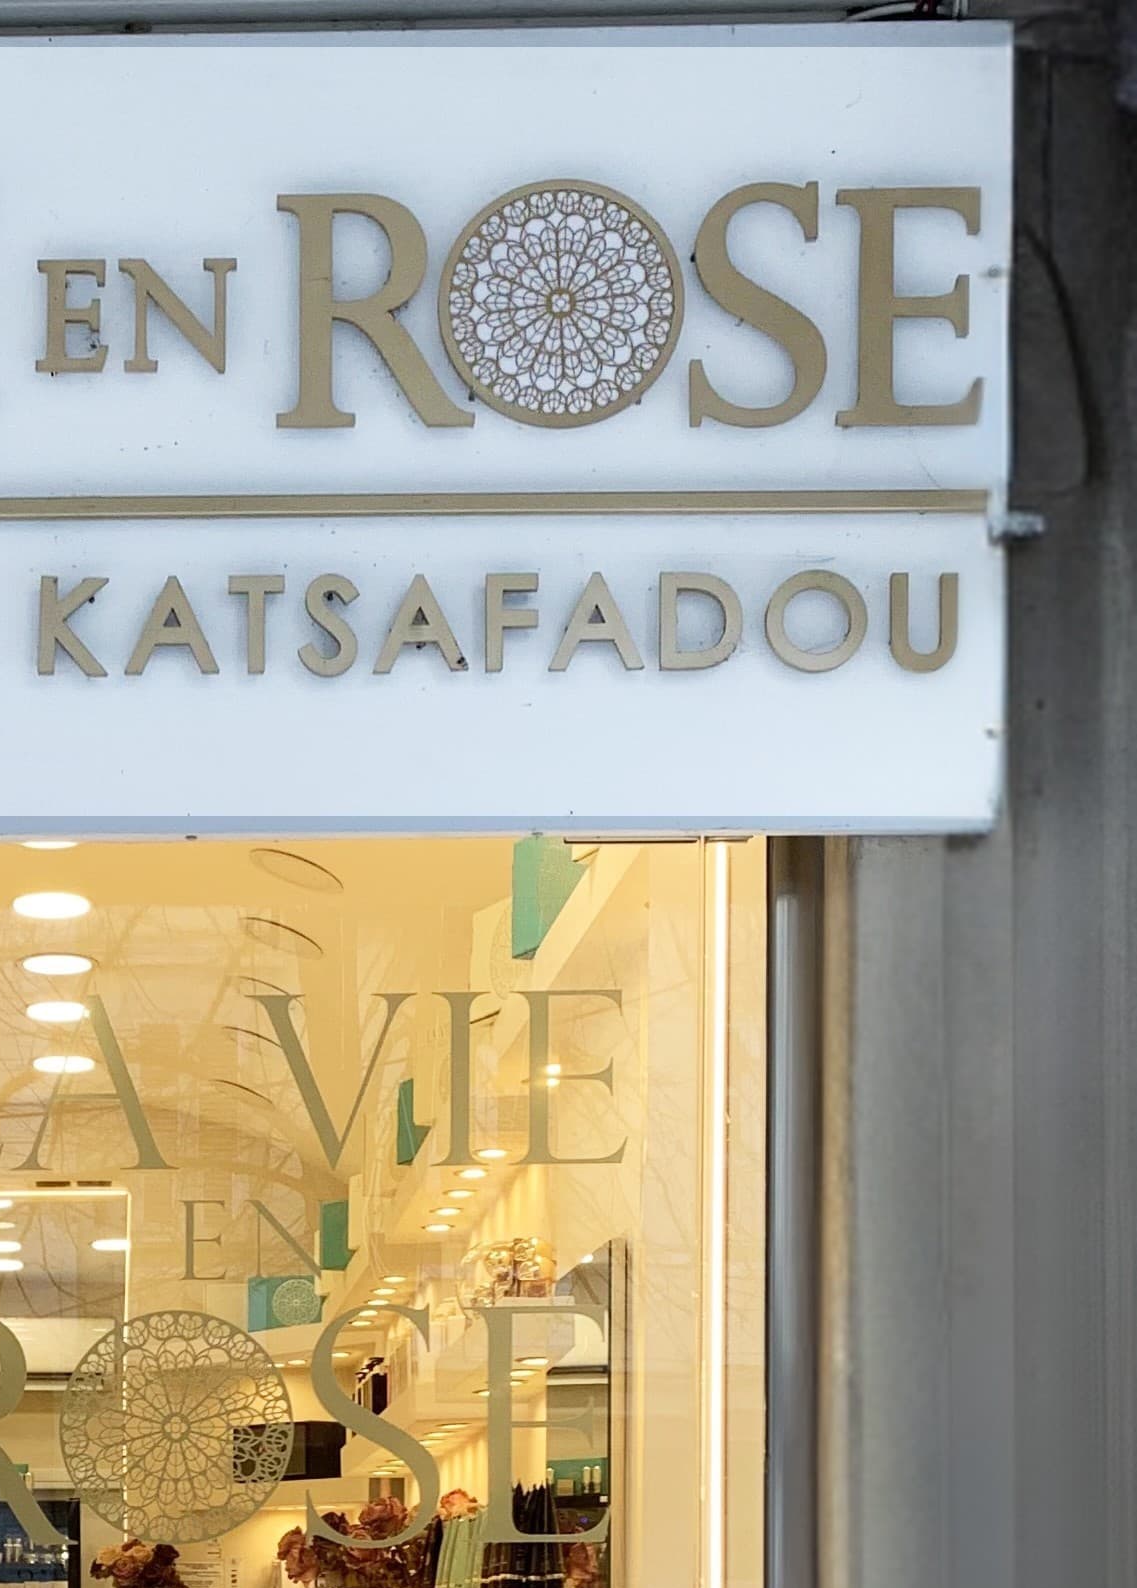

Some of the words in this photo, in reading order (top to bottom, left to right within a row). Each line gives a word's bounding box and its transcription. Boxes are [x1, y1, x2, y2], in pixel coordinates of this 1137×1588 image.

[35, 258, 238, 376] EN
[275, 178, 984, 430] ROSE
[37, 570, 959, 680] KATSAFADOU
[246, 989, 628, 1172] VIE
[181, 1199, 324, 1282] EN
